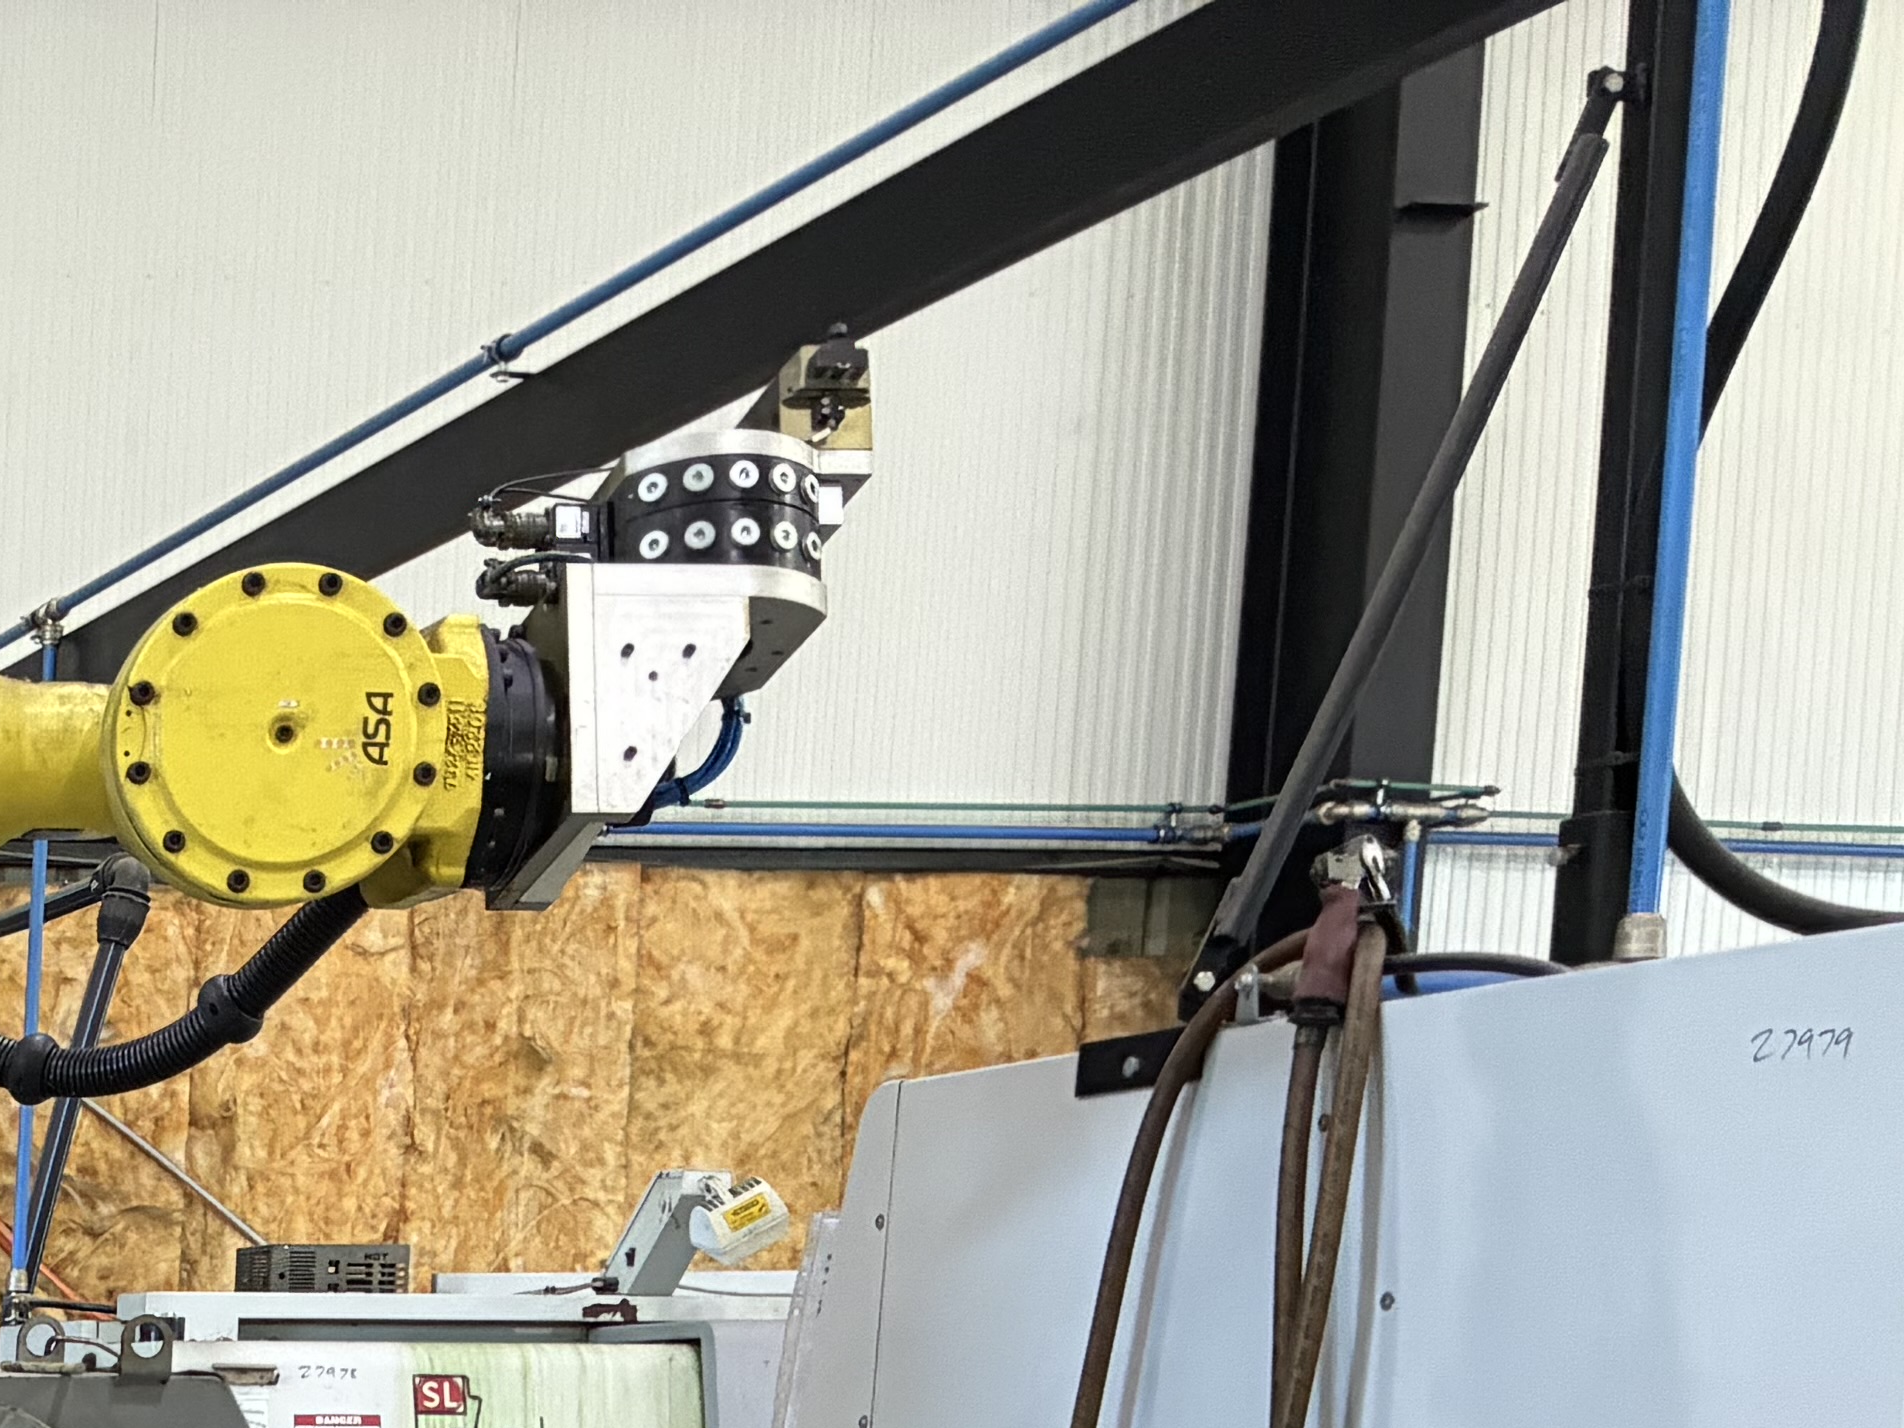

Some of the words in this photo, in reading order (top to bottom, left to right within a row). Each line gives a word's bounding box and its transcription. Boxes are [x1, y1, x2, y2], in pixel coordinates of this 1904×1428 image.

[361, 691, 394, 766] ASA
[1750, 1027, 1854, 1062] 27979
[422, 1381, 458, 1409] SL
[315, 1415, 362, 1425] DANGER
